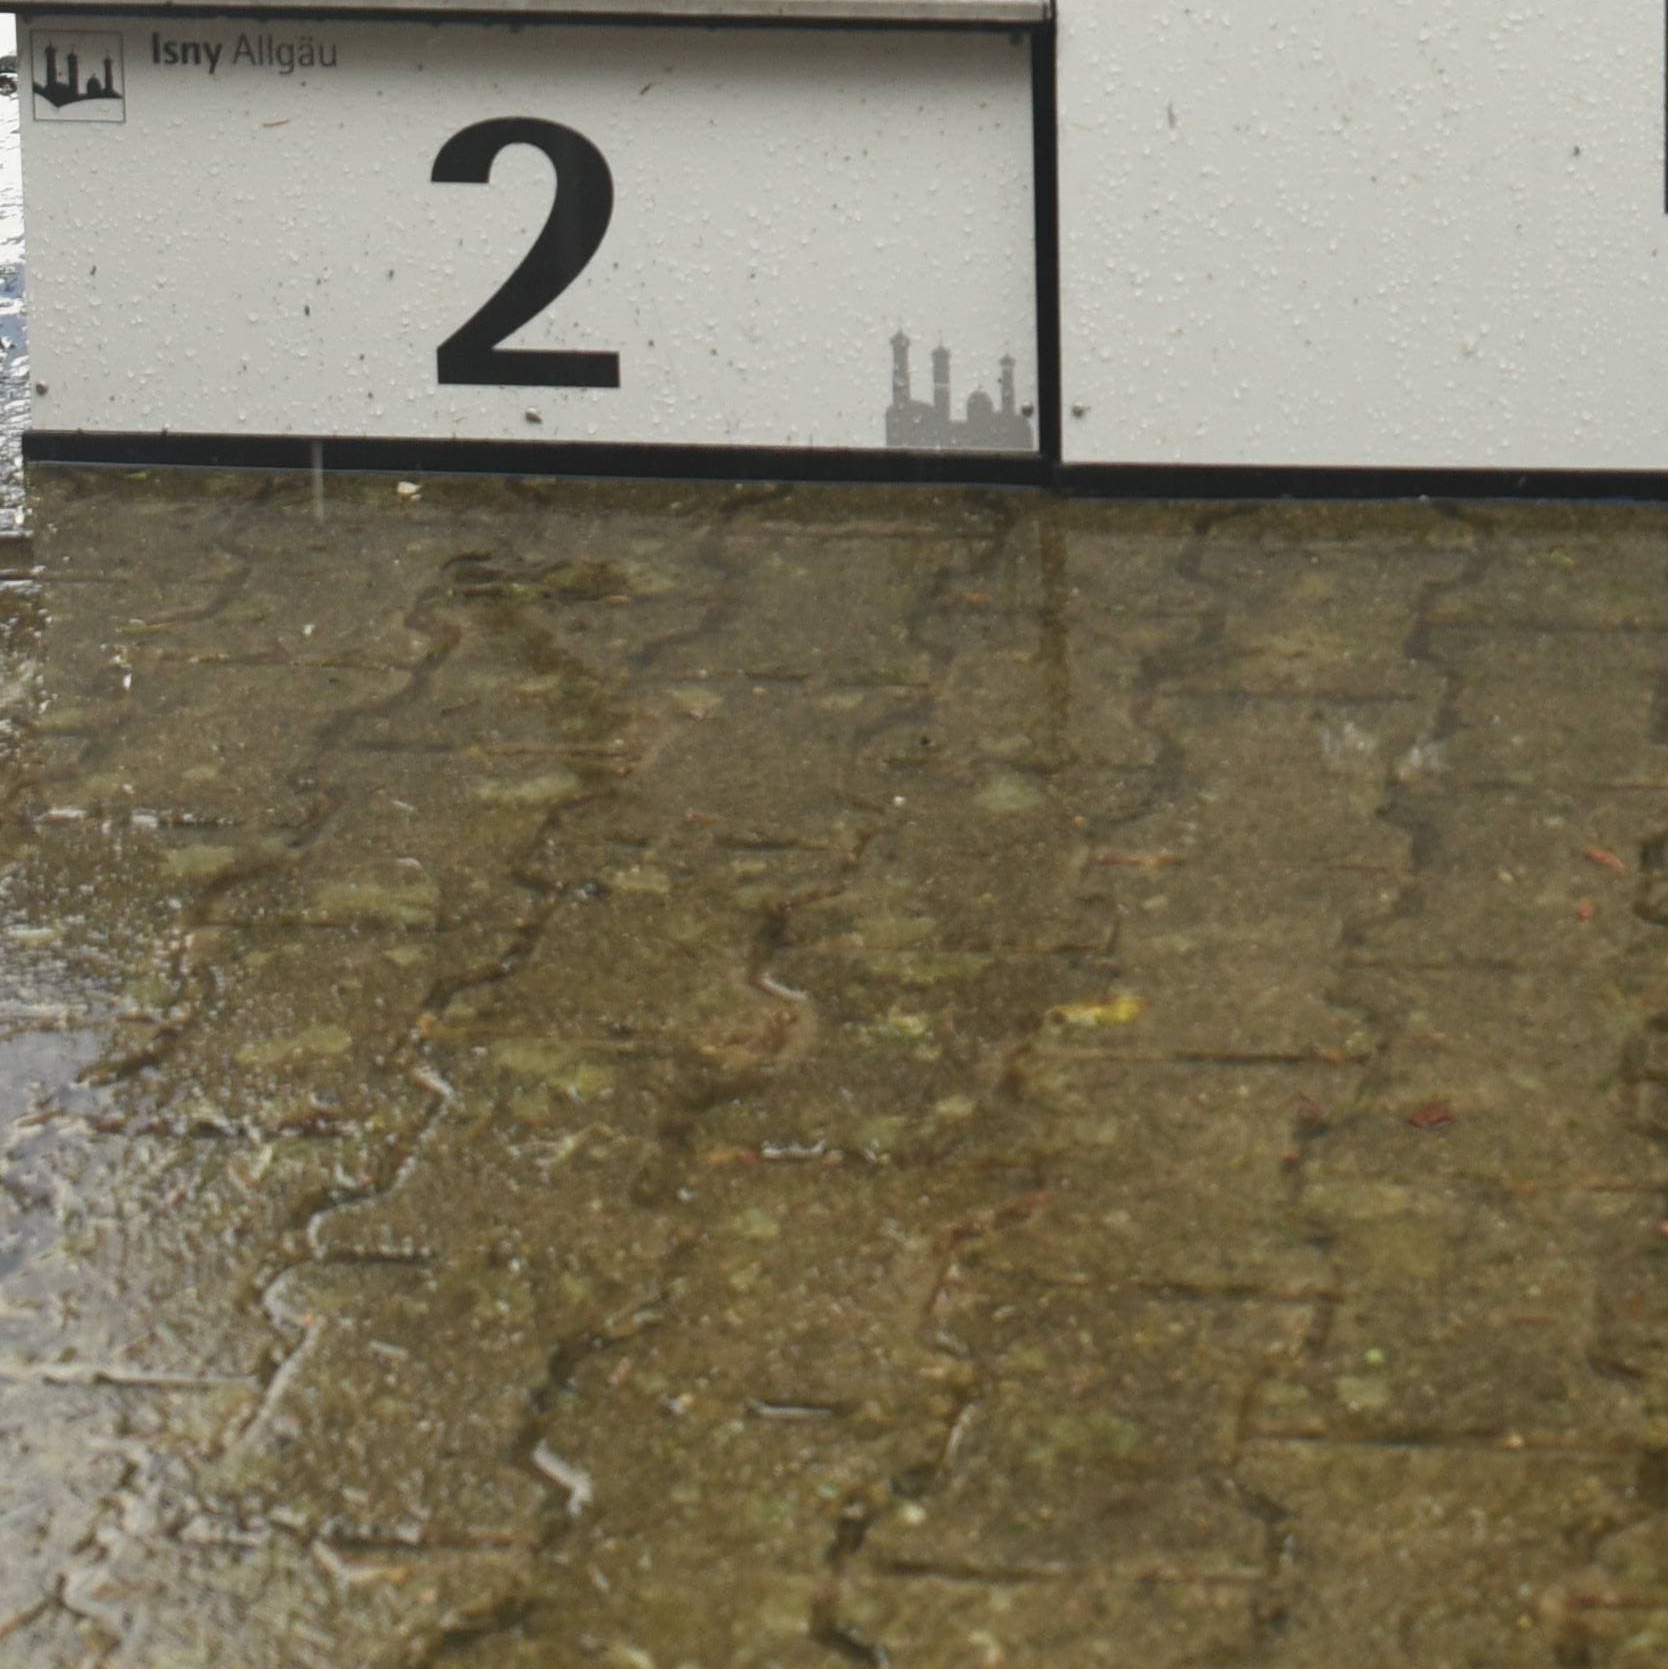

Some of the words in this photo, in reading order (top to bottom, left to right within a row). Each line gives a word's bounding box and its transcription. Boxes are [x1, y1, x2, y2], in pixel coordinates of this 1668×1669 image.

[151, 31, 223, 75] Isny
[231, 32, 337, 75] Allgäu
[431, 115, 620, 388] 2
